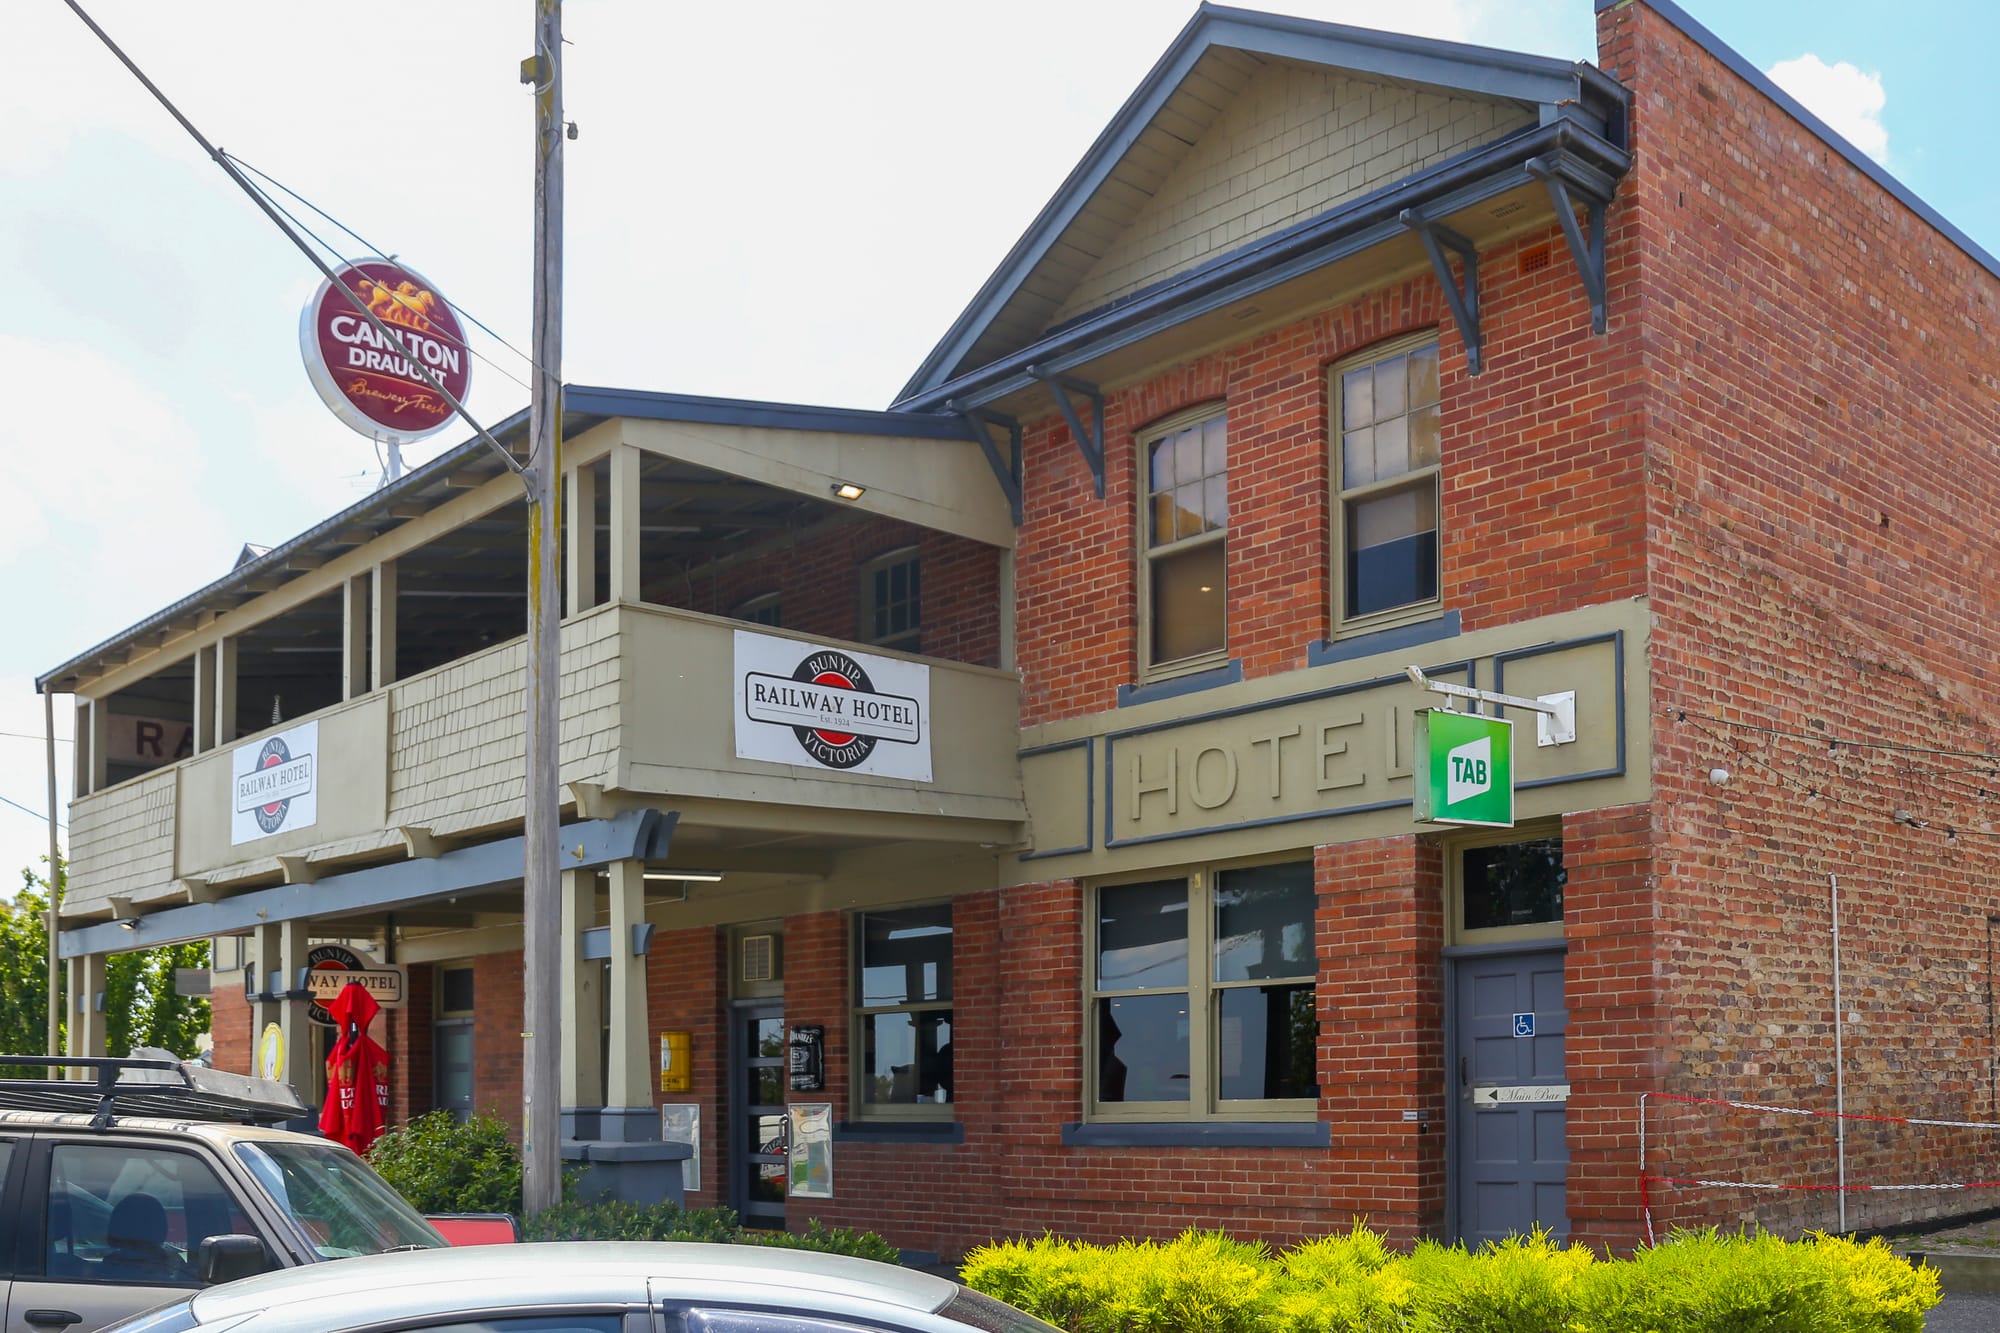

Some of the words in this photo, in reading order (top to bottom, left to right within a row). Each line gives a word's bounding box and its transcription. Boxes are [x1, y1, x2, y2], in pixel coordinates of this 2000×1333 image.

[330, 316, 460, 375] CARLTON
[348, 378, 409, 413] Brewery
[410, 394, 446, 415] Fresh
[809, 655, 860, 682] BUNYIP
[754, 683, 845, 714] RAILWAY
[853, 699, 914, 725] HOTEL
[820, 714, 832, 723] Est.
[834, 717, 850, 727] 1924
[262, 741, 286, 761] BUNYIP
[804, 731, 869, 763] VICTORIA
[1130, 706, 1414, 820] HOTEL
[1452, 756, 1487, 786] TAB
[240, 773, 277, 798] RAILWAY
[280, 763, 309, 786] HOTEL
[258, 804, 287, 829] VICTORIA
[311, 949, 353, 964] BUNYIP
[1501, 1088, 1531, 1101] Main
[1534, 1087, 1560, 1101] Bar
